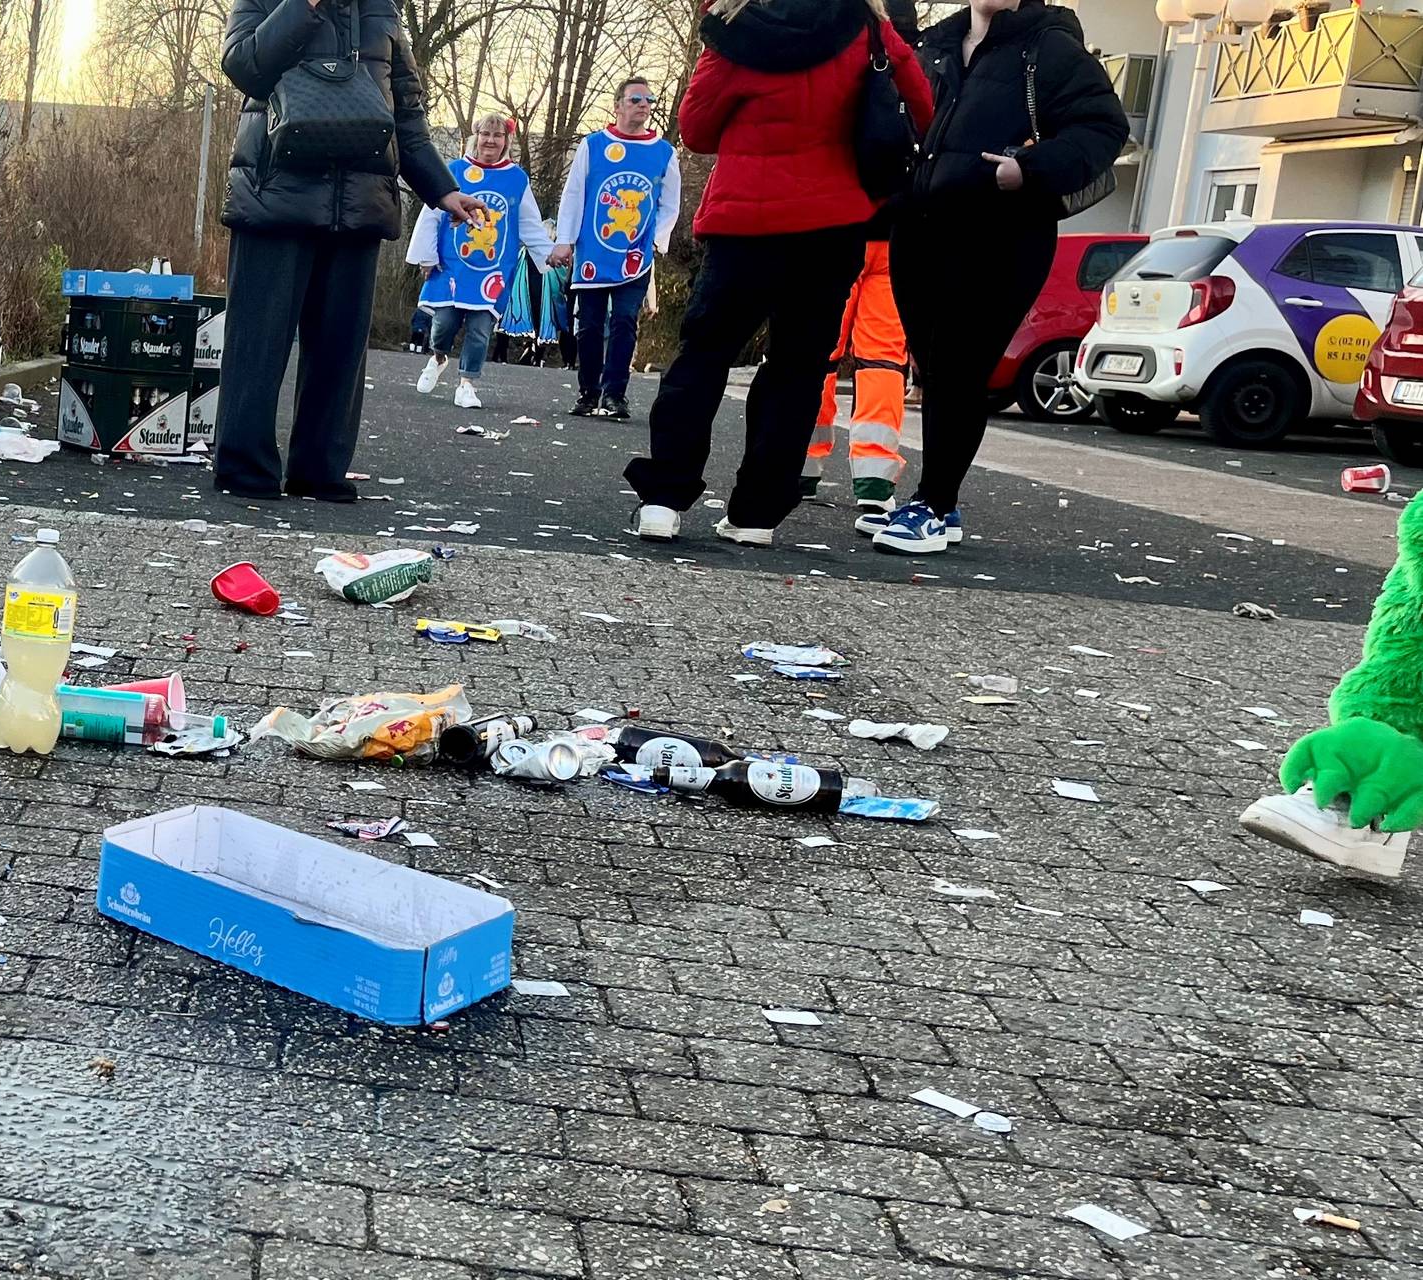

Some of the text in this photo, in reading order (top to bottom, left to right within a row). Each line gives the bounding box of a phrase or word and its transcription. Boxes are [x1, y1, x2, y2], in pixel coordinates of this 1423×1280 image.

[142, 341, 171, 355] Stauder
[194, 345, 221, 361] uder
[1327, 351, 1339, 360] 85
[188, 420, 213, 435] uder
[138, 428, 182, 446] Stauder
[206, 917, 266, 967] Helles
